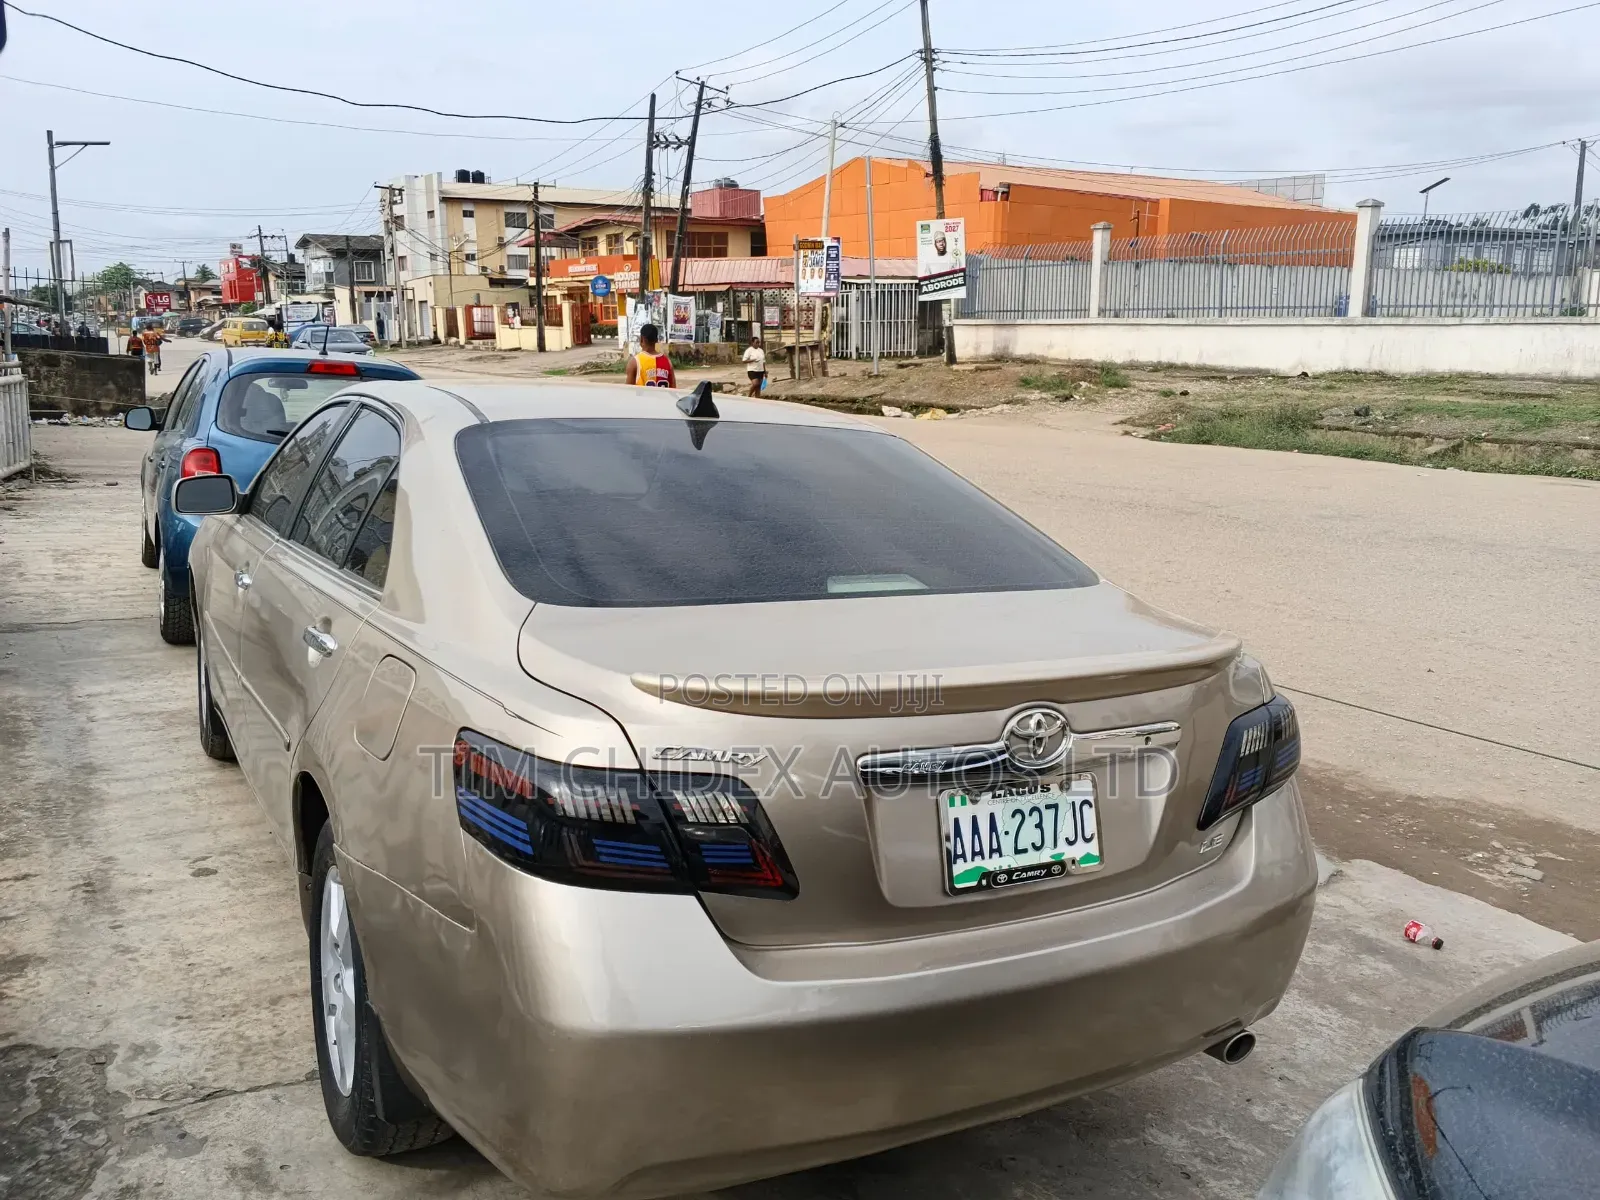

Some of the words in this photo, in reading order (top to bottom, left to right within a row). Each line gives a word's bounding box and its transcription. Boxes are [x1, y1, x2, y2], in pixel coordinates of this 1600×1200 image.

[922, 277, 964, 293] ABORODE
[157, 295, 169, 303] LG
[652, 745, 768, 767] CAMRY
[1199, 834, 1224, 853] LE
[1012, 868, 1047, 880] CAMRY
